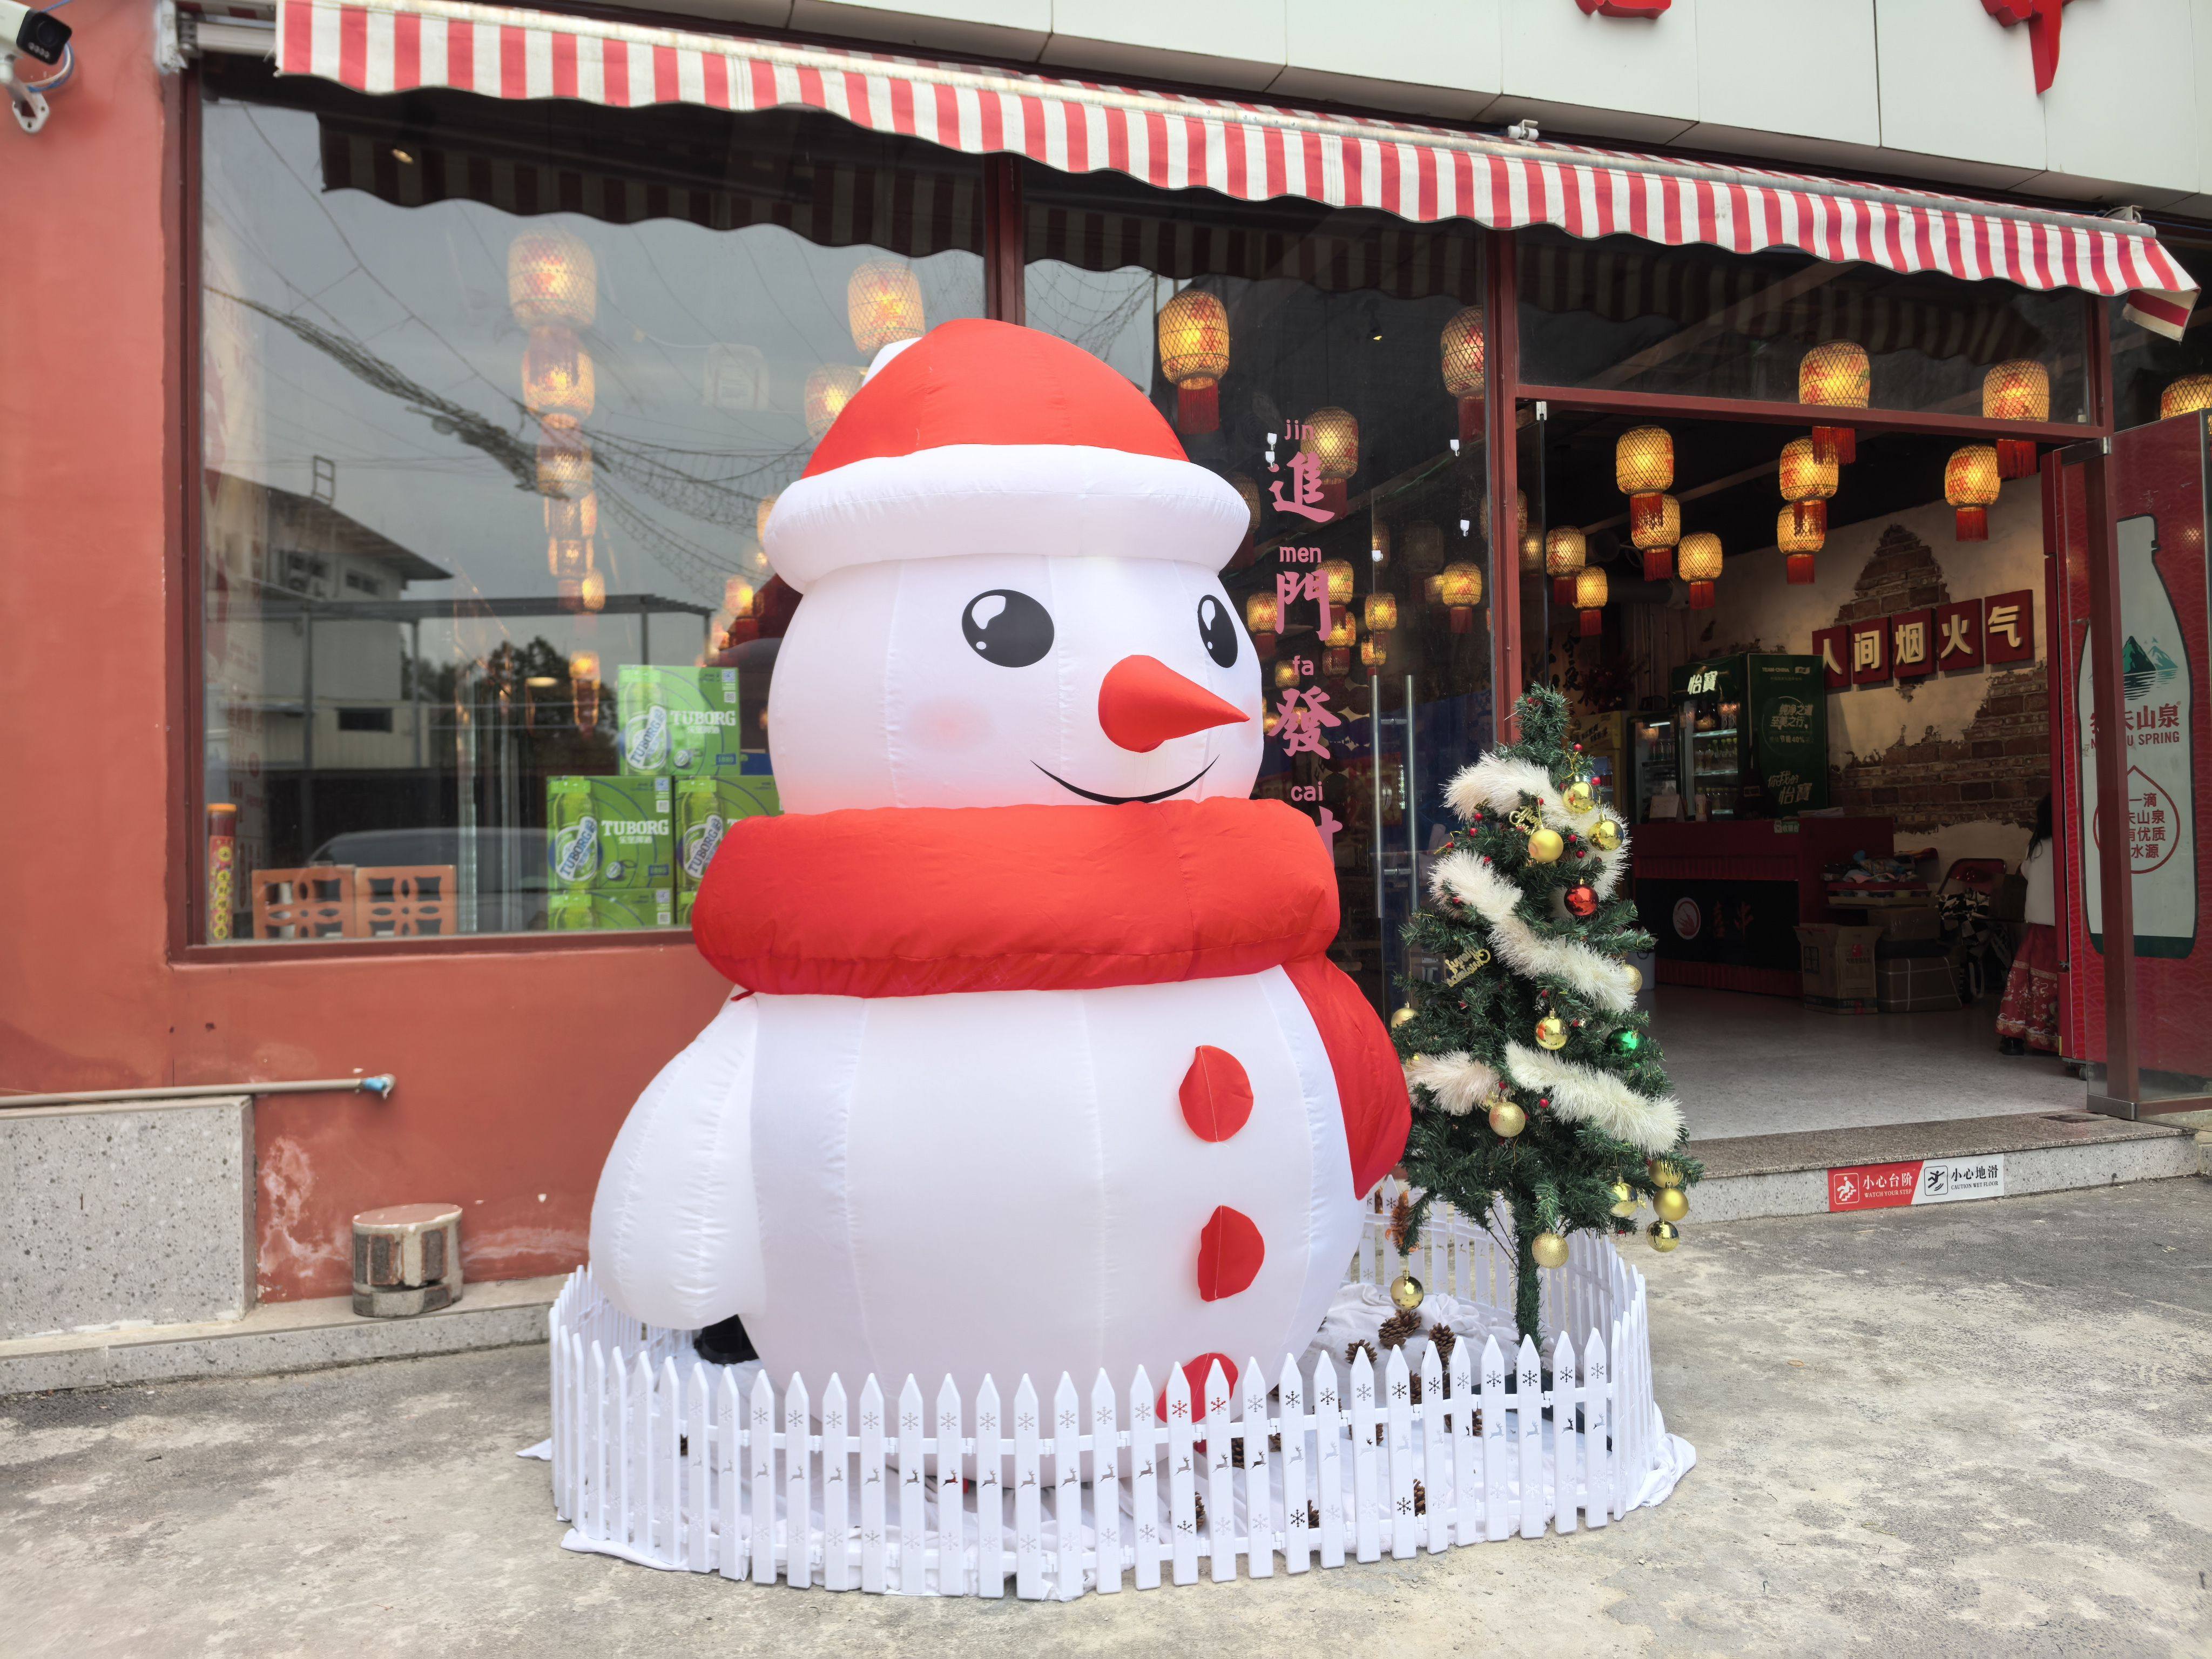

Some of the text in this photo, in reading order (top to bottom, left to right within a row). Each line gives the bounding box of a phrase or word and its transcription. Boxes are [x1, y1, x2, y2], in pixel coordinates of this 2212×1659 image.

[1284, 419, 1314, 441] jin
[1279, 547, 1321, 563] men
[1823, 605, 2021, 675] 人间烟火气
[1293, 655, 1314, 676] fa
[670, 710, 736, 726] TUBORG
[630, 719, 661, 763] TUBORG
[2139, 731, 2180, 745] SPRING
[1291, 781, 1323, 801] cai
[601, 819, 669, 836] TUBORG
[560, 831, 593, 875] TUBORG
[687, 829, 718, 873] TUBORG
[2131, 844, 2159, 859] 水源
[1863, 1172, 1912, 1190] 小心台阶
[1951, 1165, 1998, 1182] 小心地滑
